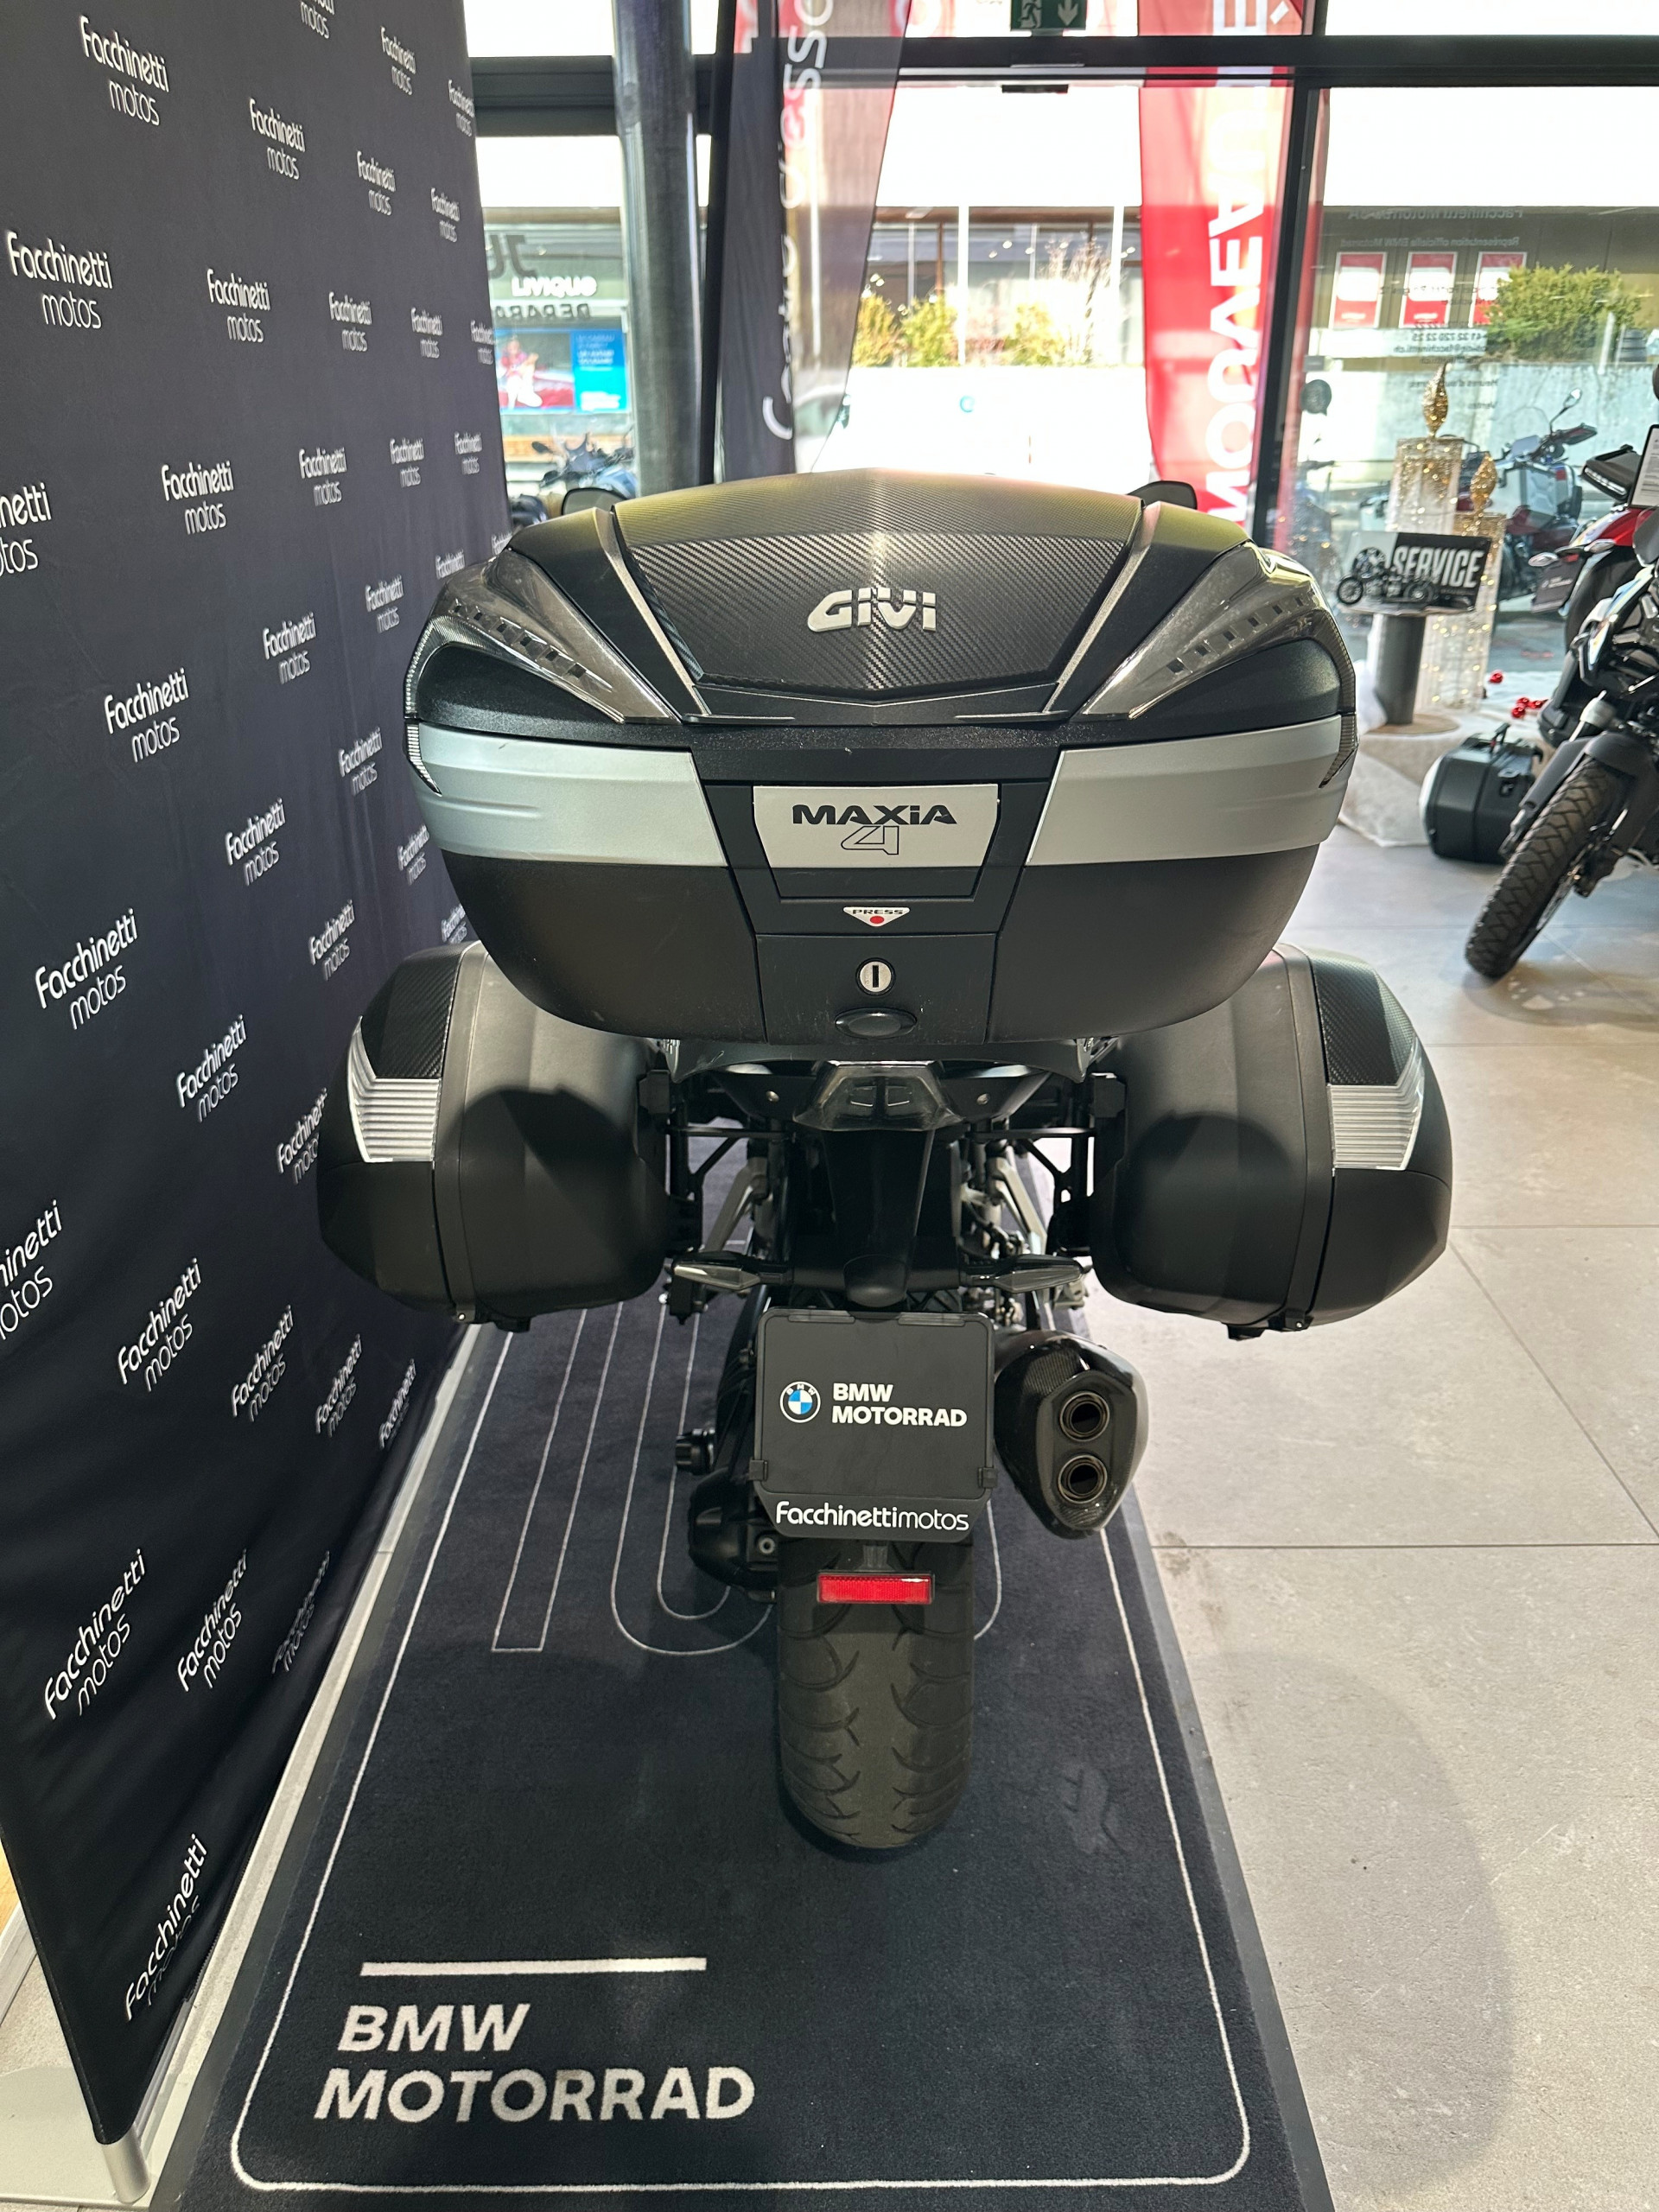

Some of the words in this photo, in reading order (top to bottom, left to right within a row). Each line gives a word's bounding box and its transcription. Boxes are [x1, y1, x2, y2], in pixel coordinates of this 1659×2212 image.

[301, 1, 330, 39] motos
[79, 16, 168, 92] Facchinetti
[109, 79, 160, 126] motos
[250, 98, 305, 153] Facchinetti
[266, 145, 300, 181] motos
[357, 150, 396, 193] Facchinetti
[6, 230, 113, 289] Facchinetti
[41, 290, 102, 330] motos
[207, 268, 270, 312] Facchinetti
[328, 291, 372, 327] Facchinetti
[226, 311, 264, 344] motos
[341, 326, 368, 353] motos
[161, 461, 234, 501] Facchinetti
[298, 446, 346, 479] Facchinetti
[314, 480, 342, 505] motos
[184, 502, 226, 535] motos
[365, 575, 404, 613] Facchinetti
[263, 611, 316, 660] Facchinetti
[278, 648, 311, 684] motos
[104, 667, 189, 734] Facchinetti
[132, 717, 180, 763] motos
[338, 726, 382, 777] Facchinetti
[225, 798, 286, 866] Facchinetti
[244, 841, 280, 886] motos
[308, 899, 355, 966] Facchinetti
[35, 908, 139, 1009] Facchinetti
[322, 938, 350, 981] motos
[69, 964, 128, 1031] motos
[176, 1014, 247, 1109] Facchinetti
[196, 1062, 239, 1123] motos
[118, 1257, 201, 1384] Facchinetti
[143, 1313, 193, 1391] motos
[232, 1305, 294, 1418] Facchinetti
[248, 1352, 286, 1421] motos
[315, 1334, 362, 1434] Facchinetti
[832, 1382, 893, 1402] BMW
[831, 1405, 968, 1427] MOTORRAD
[44, 1548, 145, 1720] Facchinetti
[177, 1548, 247, 1692] Facchinetti
[77, 1613, 130, 1716] motos
[204, 1603, 242, 1690] motos
[126, 1834, 207, 2021] Facchinetti
[337, 2003, 531, 2052] BMW
[314, 2066, 756, 2122] MOTORRAD
